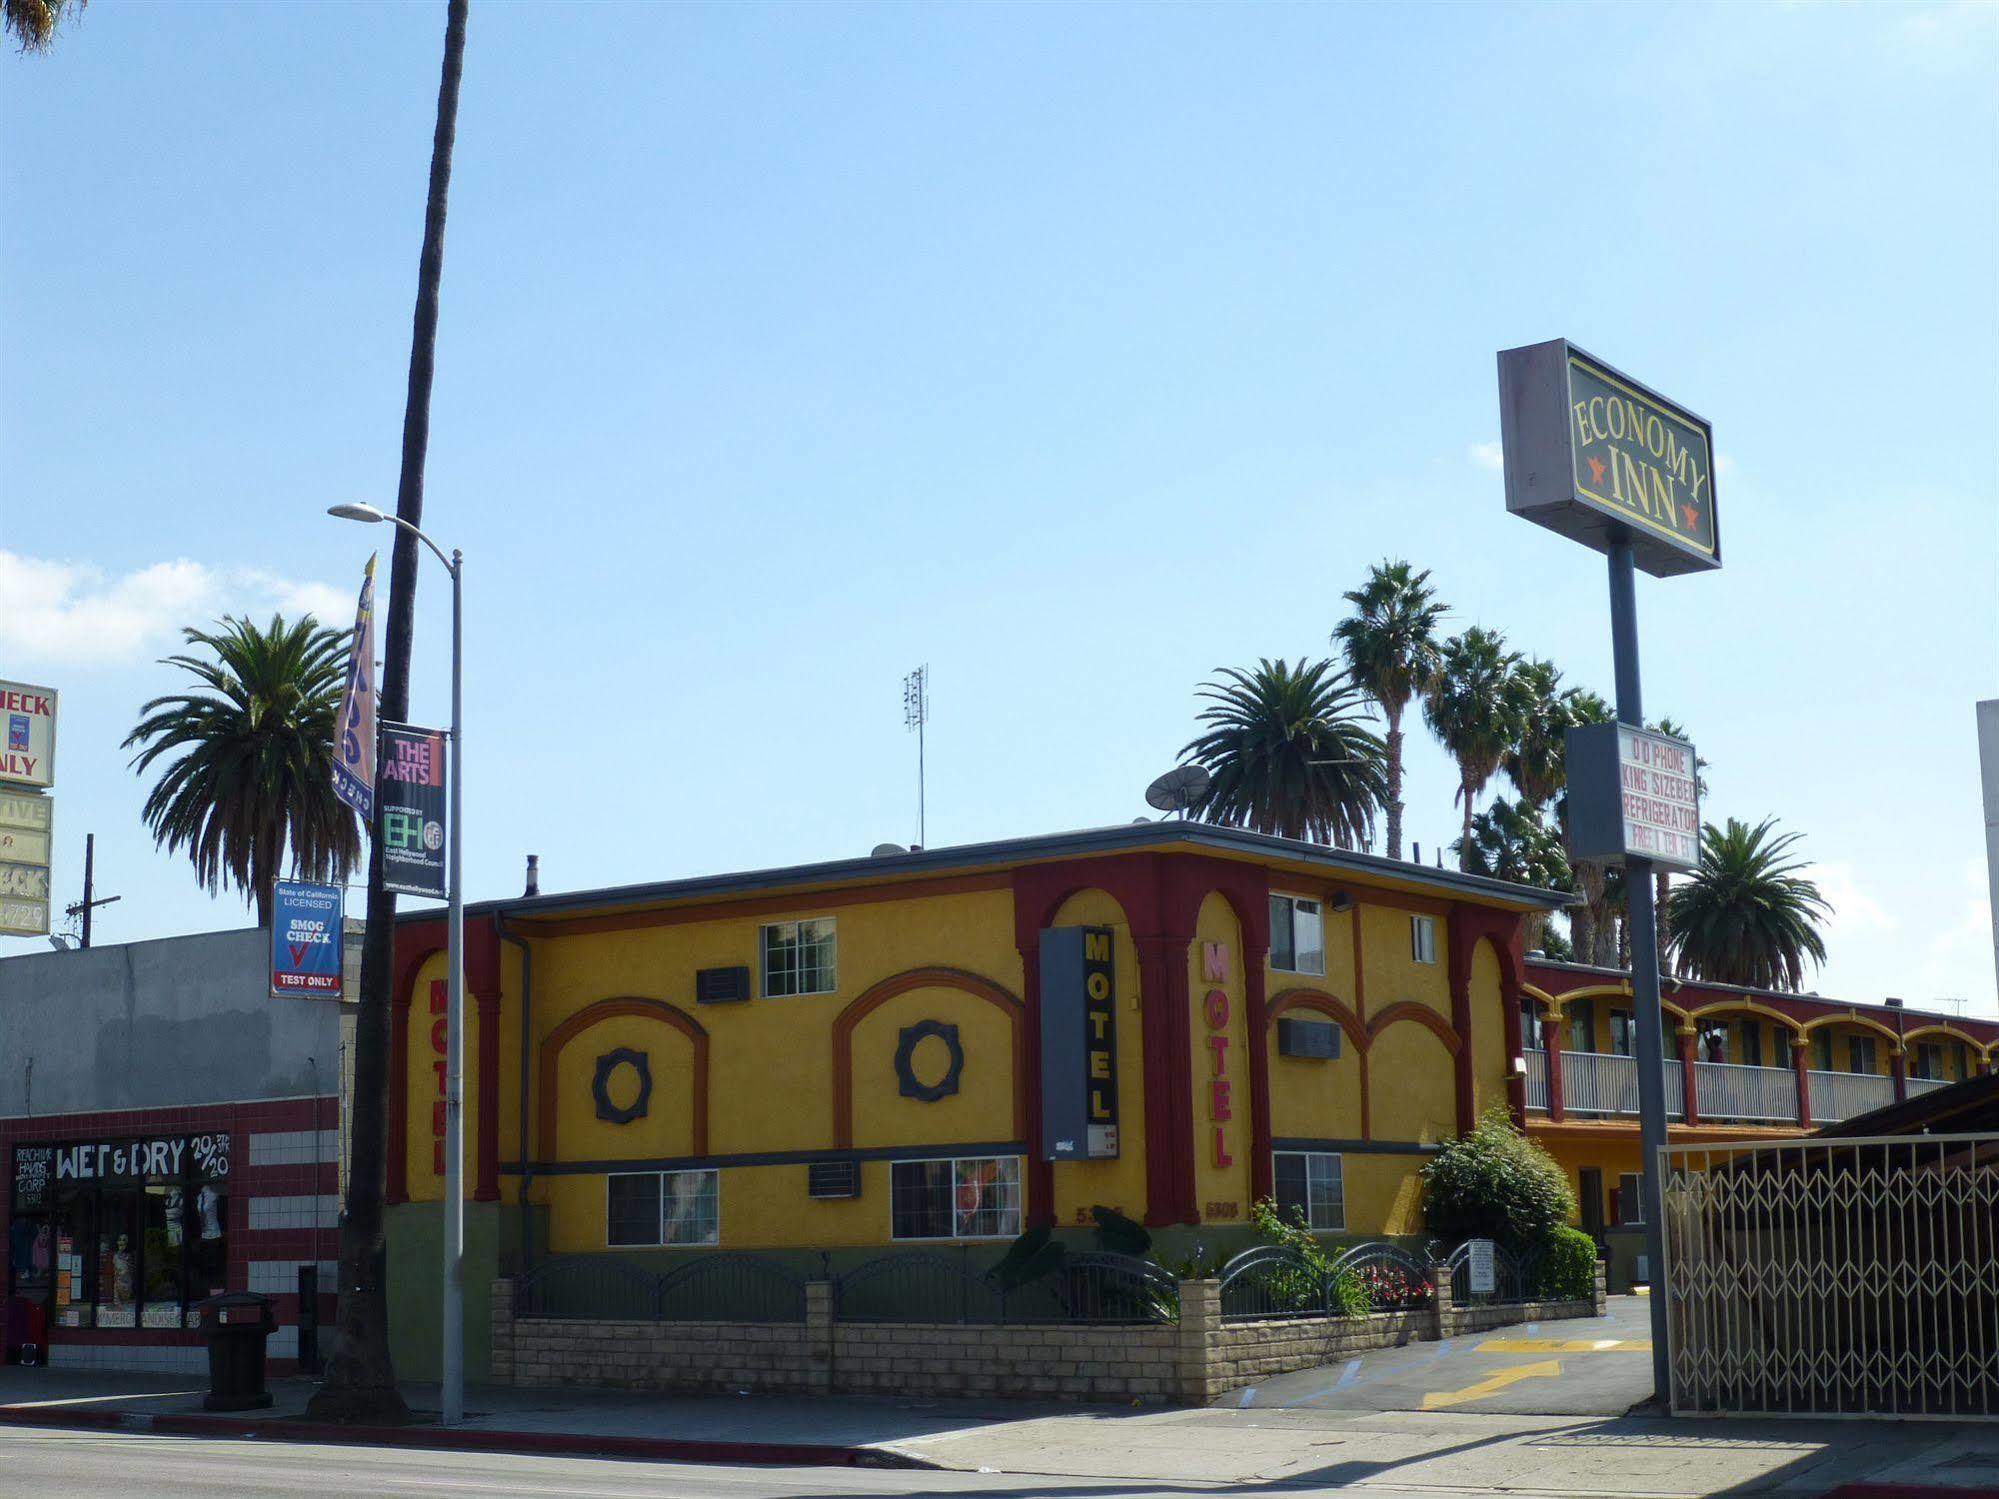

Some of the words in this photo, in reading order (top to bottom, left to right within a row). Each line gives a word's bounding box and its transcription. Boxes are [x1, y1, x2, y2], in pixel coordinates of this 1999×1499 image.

[1574, 395, 1705, 503] ECONOMY
[1607, 445, 1678, 528] INN
[396, 739, 430, 764] THE
[384, 759, 430, 785] ARTS
[1622, 765, 1647, 792] KING
[384, 805, 415, 815] SUPPORTED
[1623, 793, 1698, 832] REFRIGERATOR
[385, 847, 398, 855] East
[399, 848, 426, 859] Hollywood
[385, 853, 424, 866] Neighborhood
[279, 888, 296, 897] State
[298, 889, 305, 897] of
[306, 890, 338, 900] California
[284, 898, 333, 909] LICENSED
[291, 919, 325, 932] SMOG
[286, 931, 331, 944] CHECK
[281, 974, 306, 986] TEST
[307, 976, 333, 987] ONLY
[1085, 932, 1111, 1119] MOTEL
[1200, 942, 1233, 1170] MOTEL
[113, 1149, 127, 1176] &
[130, 1138, 185, 1176] DRY
[18, 1178, 46, 1193] CORP
